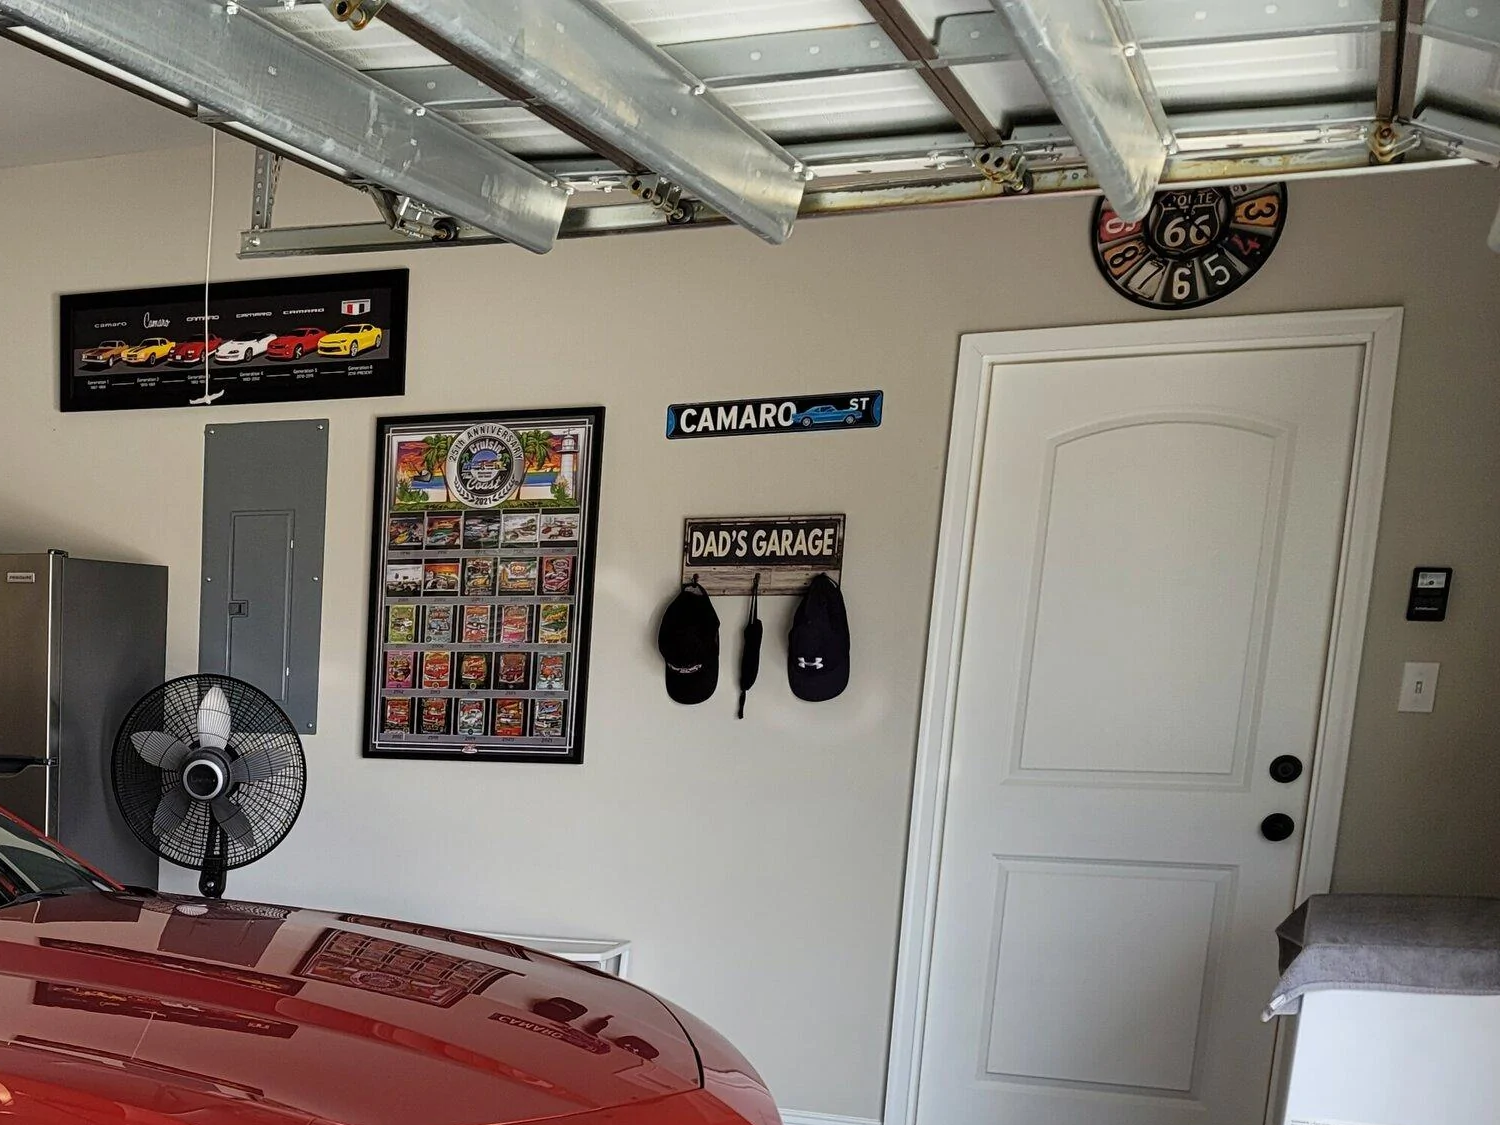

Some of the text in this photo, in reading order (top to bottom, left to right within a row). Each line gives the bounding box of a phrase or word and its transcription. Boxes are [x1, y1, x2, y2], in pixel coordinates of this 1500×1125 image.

[1171, 192, 1213, 206] OTE
[1244, 202, 1276, 220] 3
[1163, 214, 1211, 247] 66
[1109, 245, 1140, 268] 8
[1203, 253, 1231, 286] 5
[1137, 261, 1164, 290] 7
[1172, 267, 1191, 300] 6
[680, 397, 870, 433] CAMARO ST
[467, 425, 523, 460] ANNIVERSARY
[466, 477, 503, 491] Coast
[474, 496, 493, 506] 2021
[691, 528, 835, 558] DAD'S GARAGE
